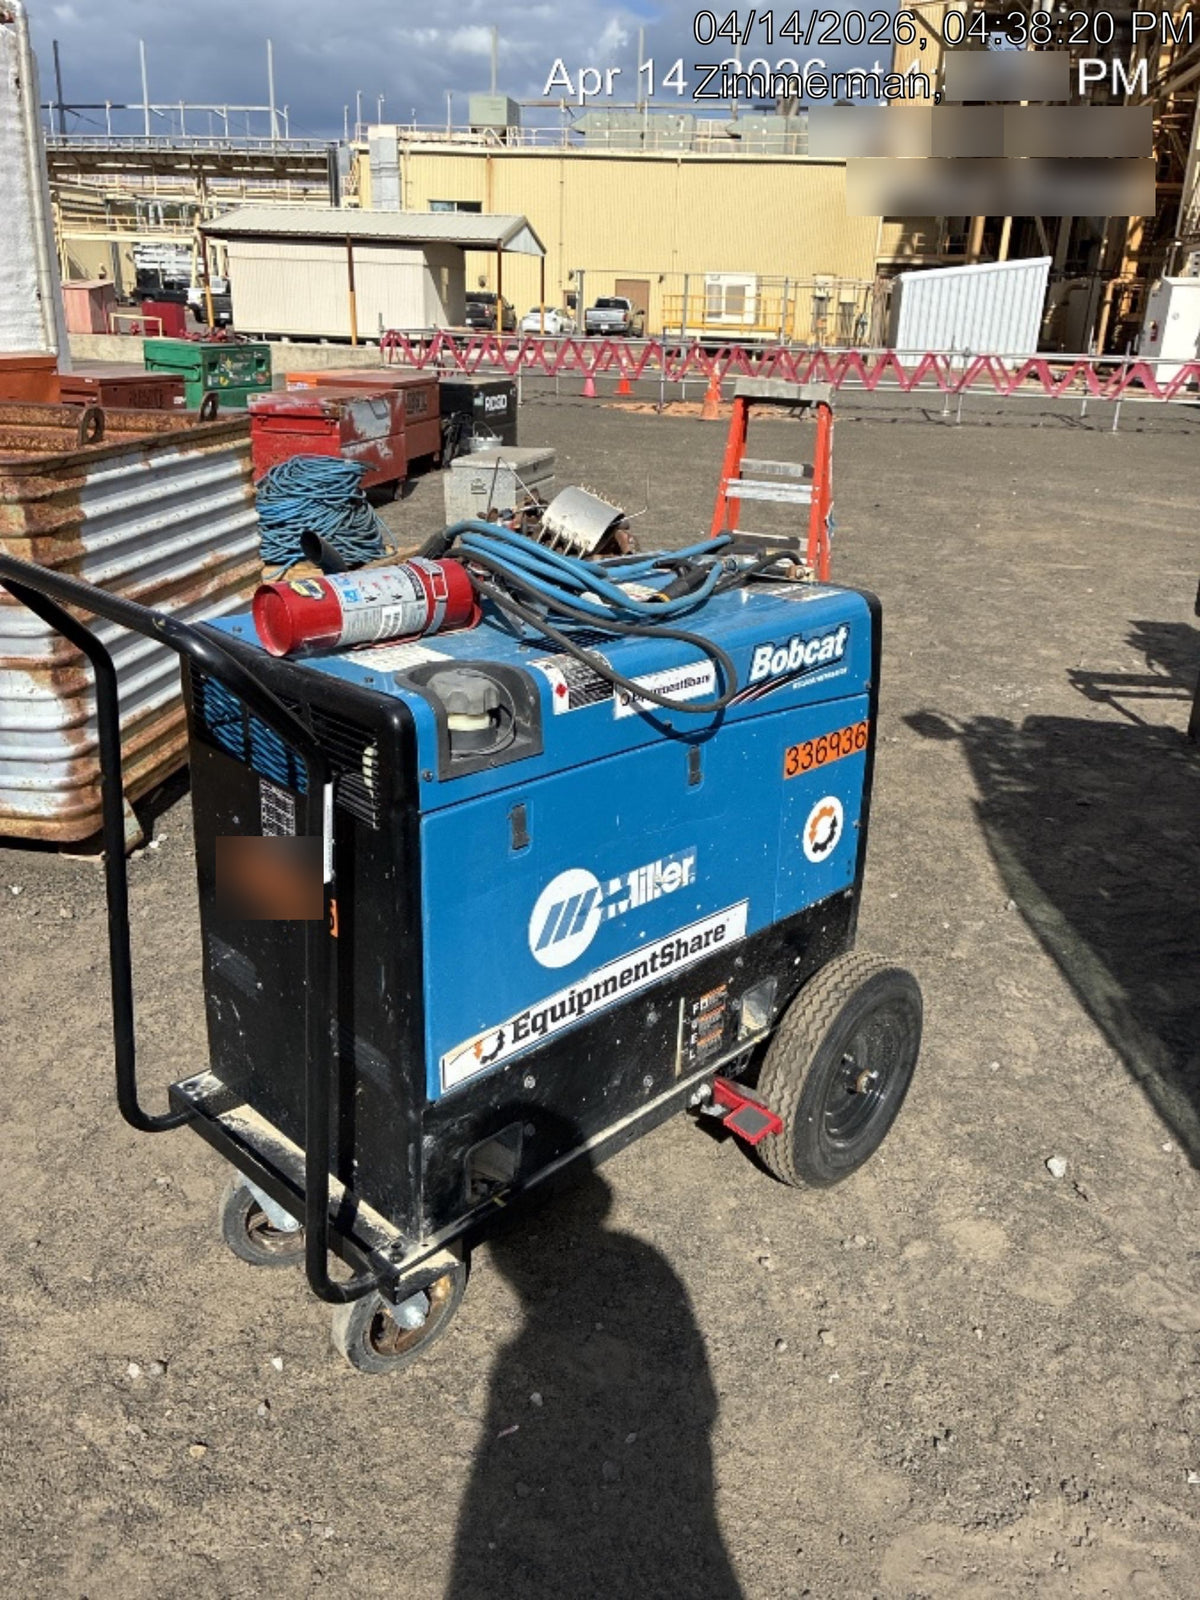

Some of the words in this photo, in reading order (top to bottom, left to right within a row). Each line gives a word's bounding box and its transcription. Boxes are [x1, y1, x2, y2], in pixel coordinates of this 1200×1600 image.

[749, 623, 849, 682] Bobcat
[786, 721, 867, 776] 336936
[606, 854, 695, 919] Miller
[511, 923, 727, 1043] EquipmentShare
